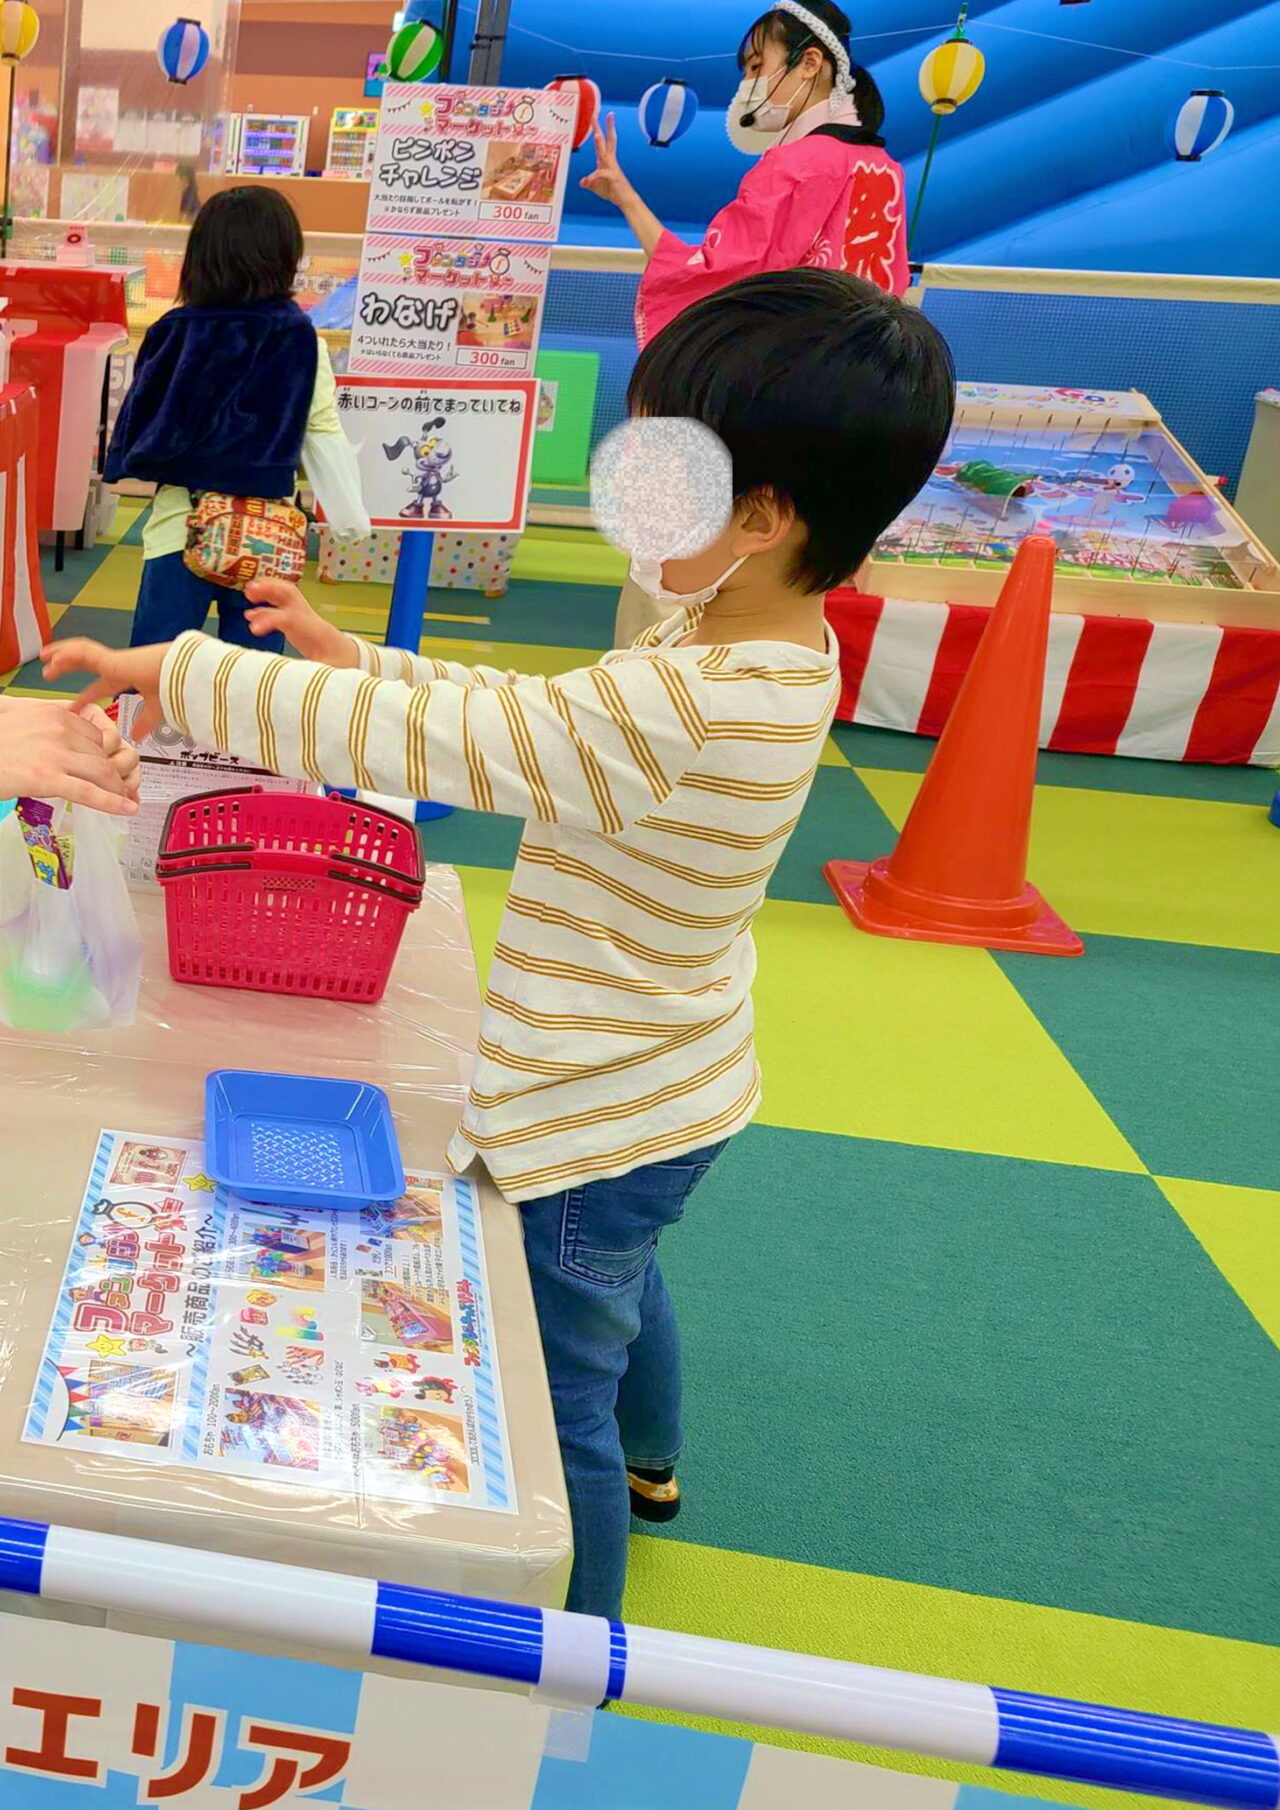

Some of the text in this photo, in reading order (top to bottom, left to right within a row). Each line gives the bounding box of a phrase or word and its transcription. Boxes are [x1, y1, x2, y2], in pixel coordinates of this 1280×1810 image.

[392, 137, 475, 163] ピンポン
[379, 162, 483, 191] チャレンジ
[492, 206, 539, 221] 300 fan
[360, 292, 459, 332] わなげ
[470, 352, 515, 367] 300 fan
